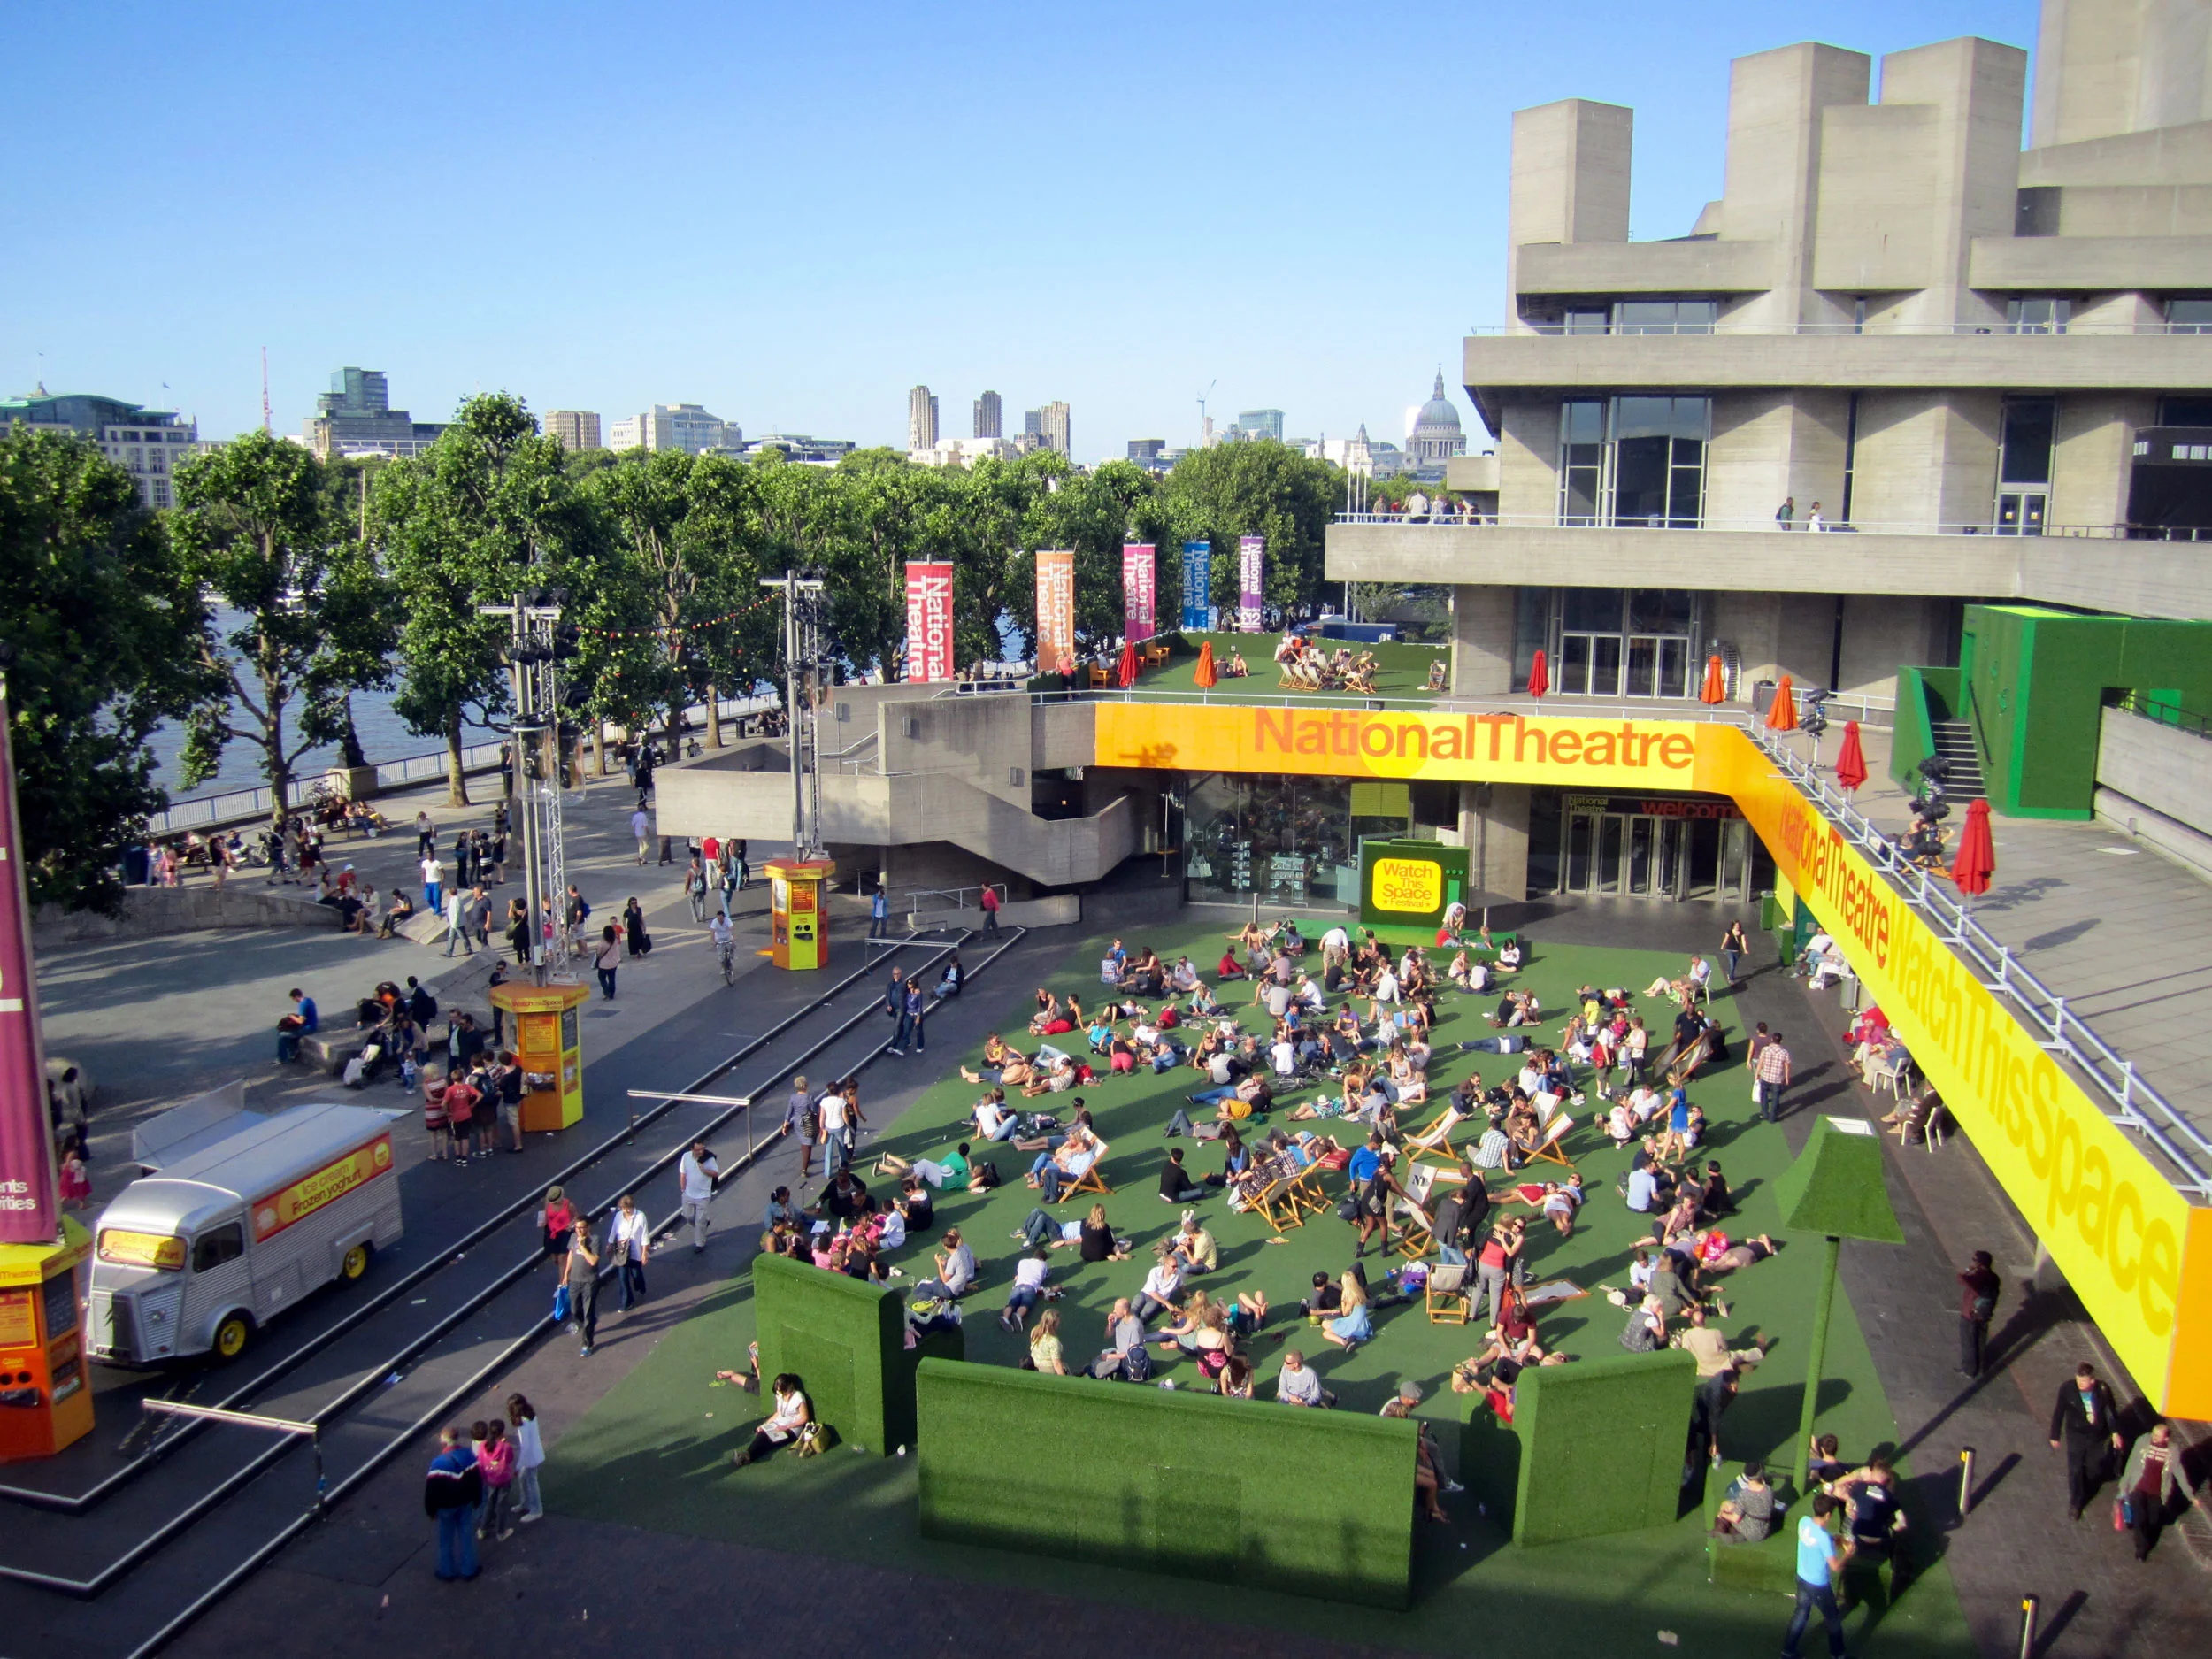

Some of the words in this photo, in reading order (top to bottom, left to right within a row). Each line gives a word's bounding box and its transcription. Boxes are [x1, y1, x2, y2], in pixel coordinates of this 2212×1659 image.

[1125, 553, 1138, 620] Theatre
[1138, 554, 1152, 624] National
[1184, 549, 1194, 607] Theatre
[1194, 550, 1208, 611] National
[1240, 543, 1250, 592] Theatre
[1250, 543, 1262, 595] National
[908, 575, 927, 677] Theatre
[1038, 562, 1053, 642] Theatre
[1054, 564, 1071, 648] National
[1240, 611, 1261, 626] £12
[926, 576, 949, 682] National
[1568, 795, 1609, 806] National
[1569, 804, 1606, 813] Theatre
[1382, 883, 1432, 901] Space
[1383, 862, 1432, 879] Watch
[1401, 878, 1424, 889] This
[1390, 897, 1424, 908] Festival
[291, 1190, 327, 1216] Frozen
[326, 1168, 363, 1199] yoghurt
[301, 1180, 319, 1196] Ice
[319, 1164, 350, 1187] cream
